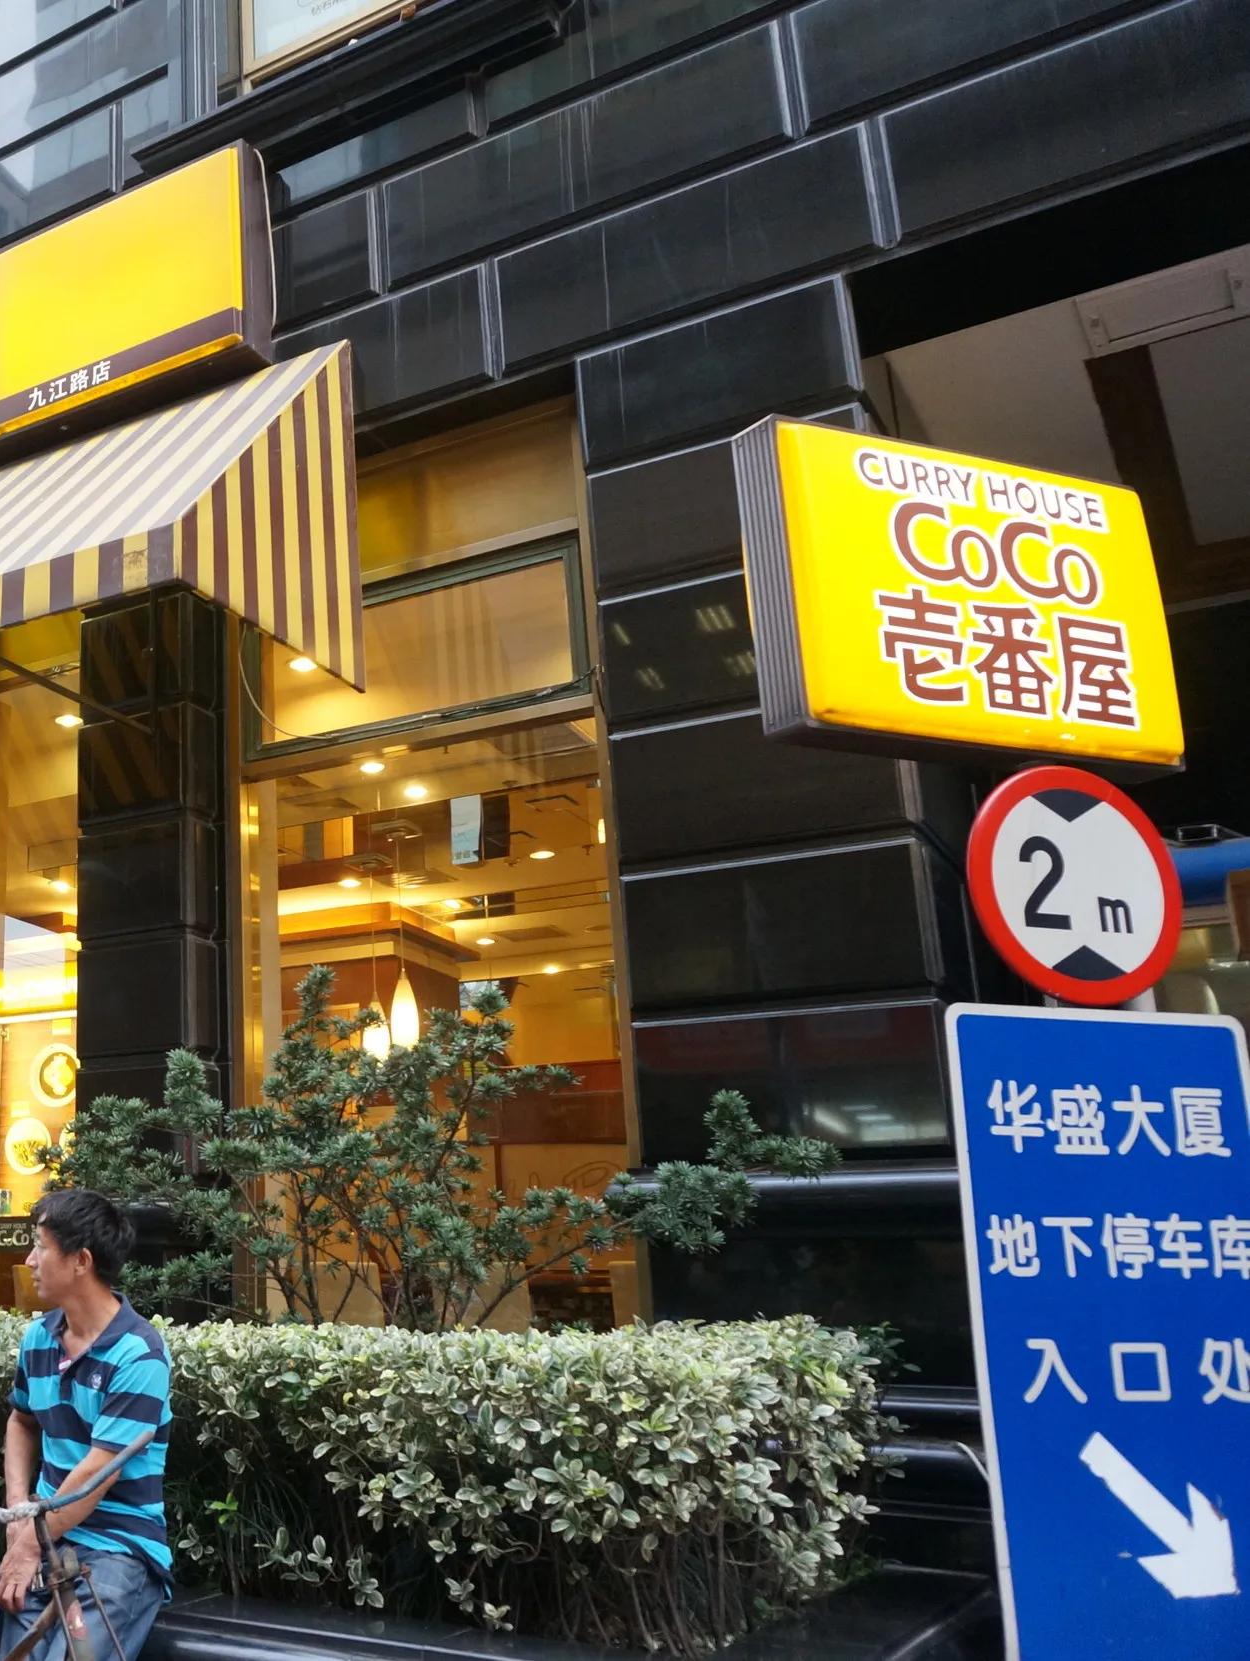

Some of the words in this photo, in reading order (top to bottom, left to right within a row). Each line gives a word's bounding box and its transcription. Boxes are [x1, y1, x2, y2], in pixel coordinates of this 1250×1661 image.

[28, 360, 111, 410] 九江路店
[858, 452, 973, 502] CURRY
[991, 473, 1103, 528] HOUSE
[894, 501, 1098, 606] CoCo
[878, 589, 1137, 727] 壱番屋
[1018, 835, 1072, 931] 2
[1098, 895, 1135, 934] m
[986, 1078, 1232, 1158] 华盛大厦
[986, 1211, 1250, 1280] 地下停车库
[1022, 1336, 1250, 1405] 入口处
